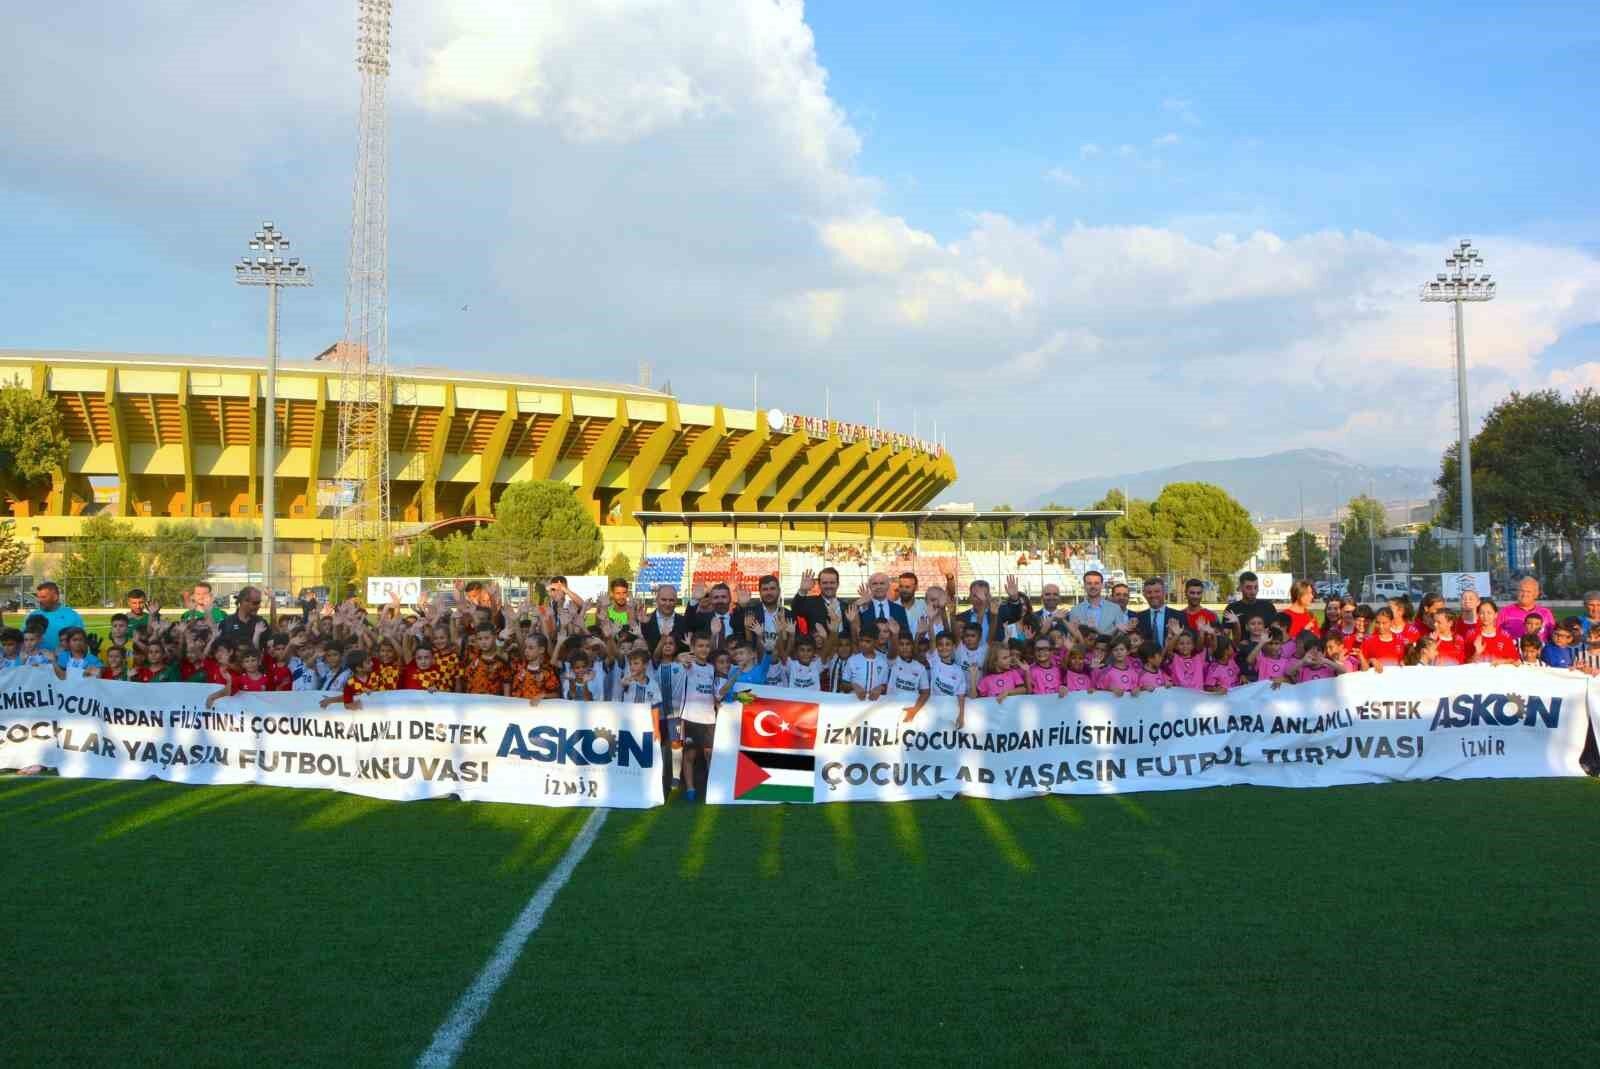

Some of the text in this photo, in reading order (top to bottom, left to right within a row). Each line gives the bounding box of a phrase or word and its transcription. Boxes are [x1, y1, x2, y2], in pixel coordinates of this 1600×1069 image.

[0, 684, 54, 710] MİRLİ
[409, 720, 488, 745] DESTEK
[1430, 692, 1563, 731] ASKON
[496, 723, 654, 768] ASKON
[824, 721, 899, 748] İZMİRLİ
[903, 729, 1043, 754] ÇOCUKLARDAN
[1048, 719, 1144, 747] FİLİSTİNLİ
[1149, 714, 1265, 746] ÇOCUKLARA
[1270, 708, 1353, 734] ANLAMLI
[1461, 735, 1505, 757] İZMİR
[123, 739, 229, 770] YAŞASIN
[239, 749, 351, 777] FUTBOL
[1004, 758, 1126, 790] YAŞASIN
[545, 774, 598, 797] İZMİR
